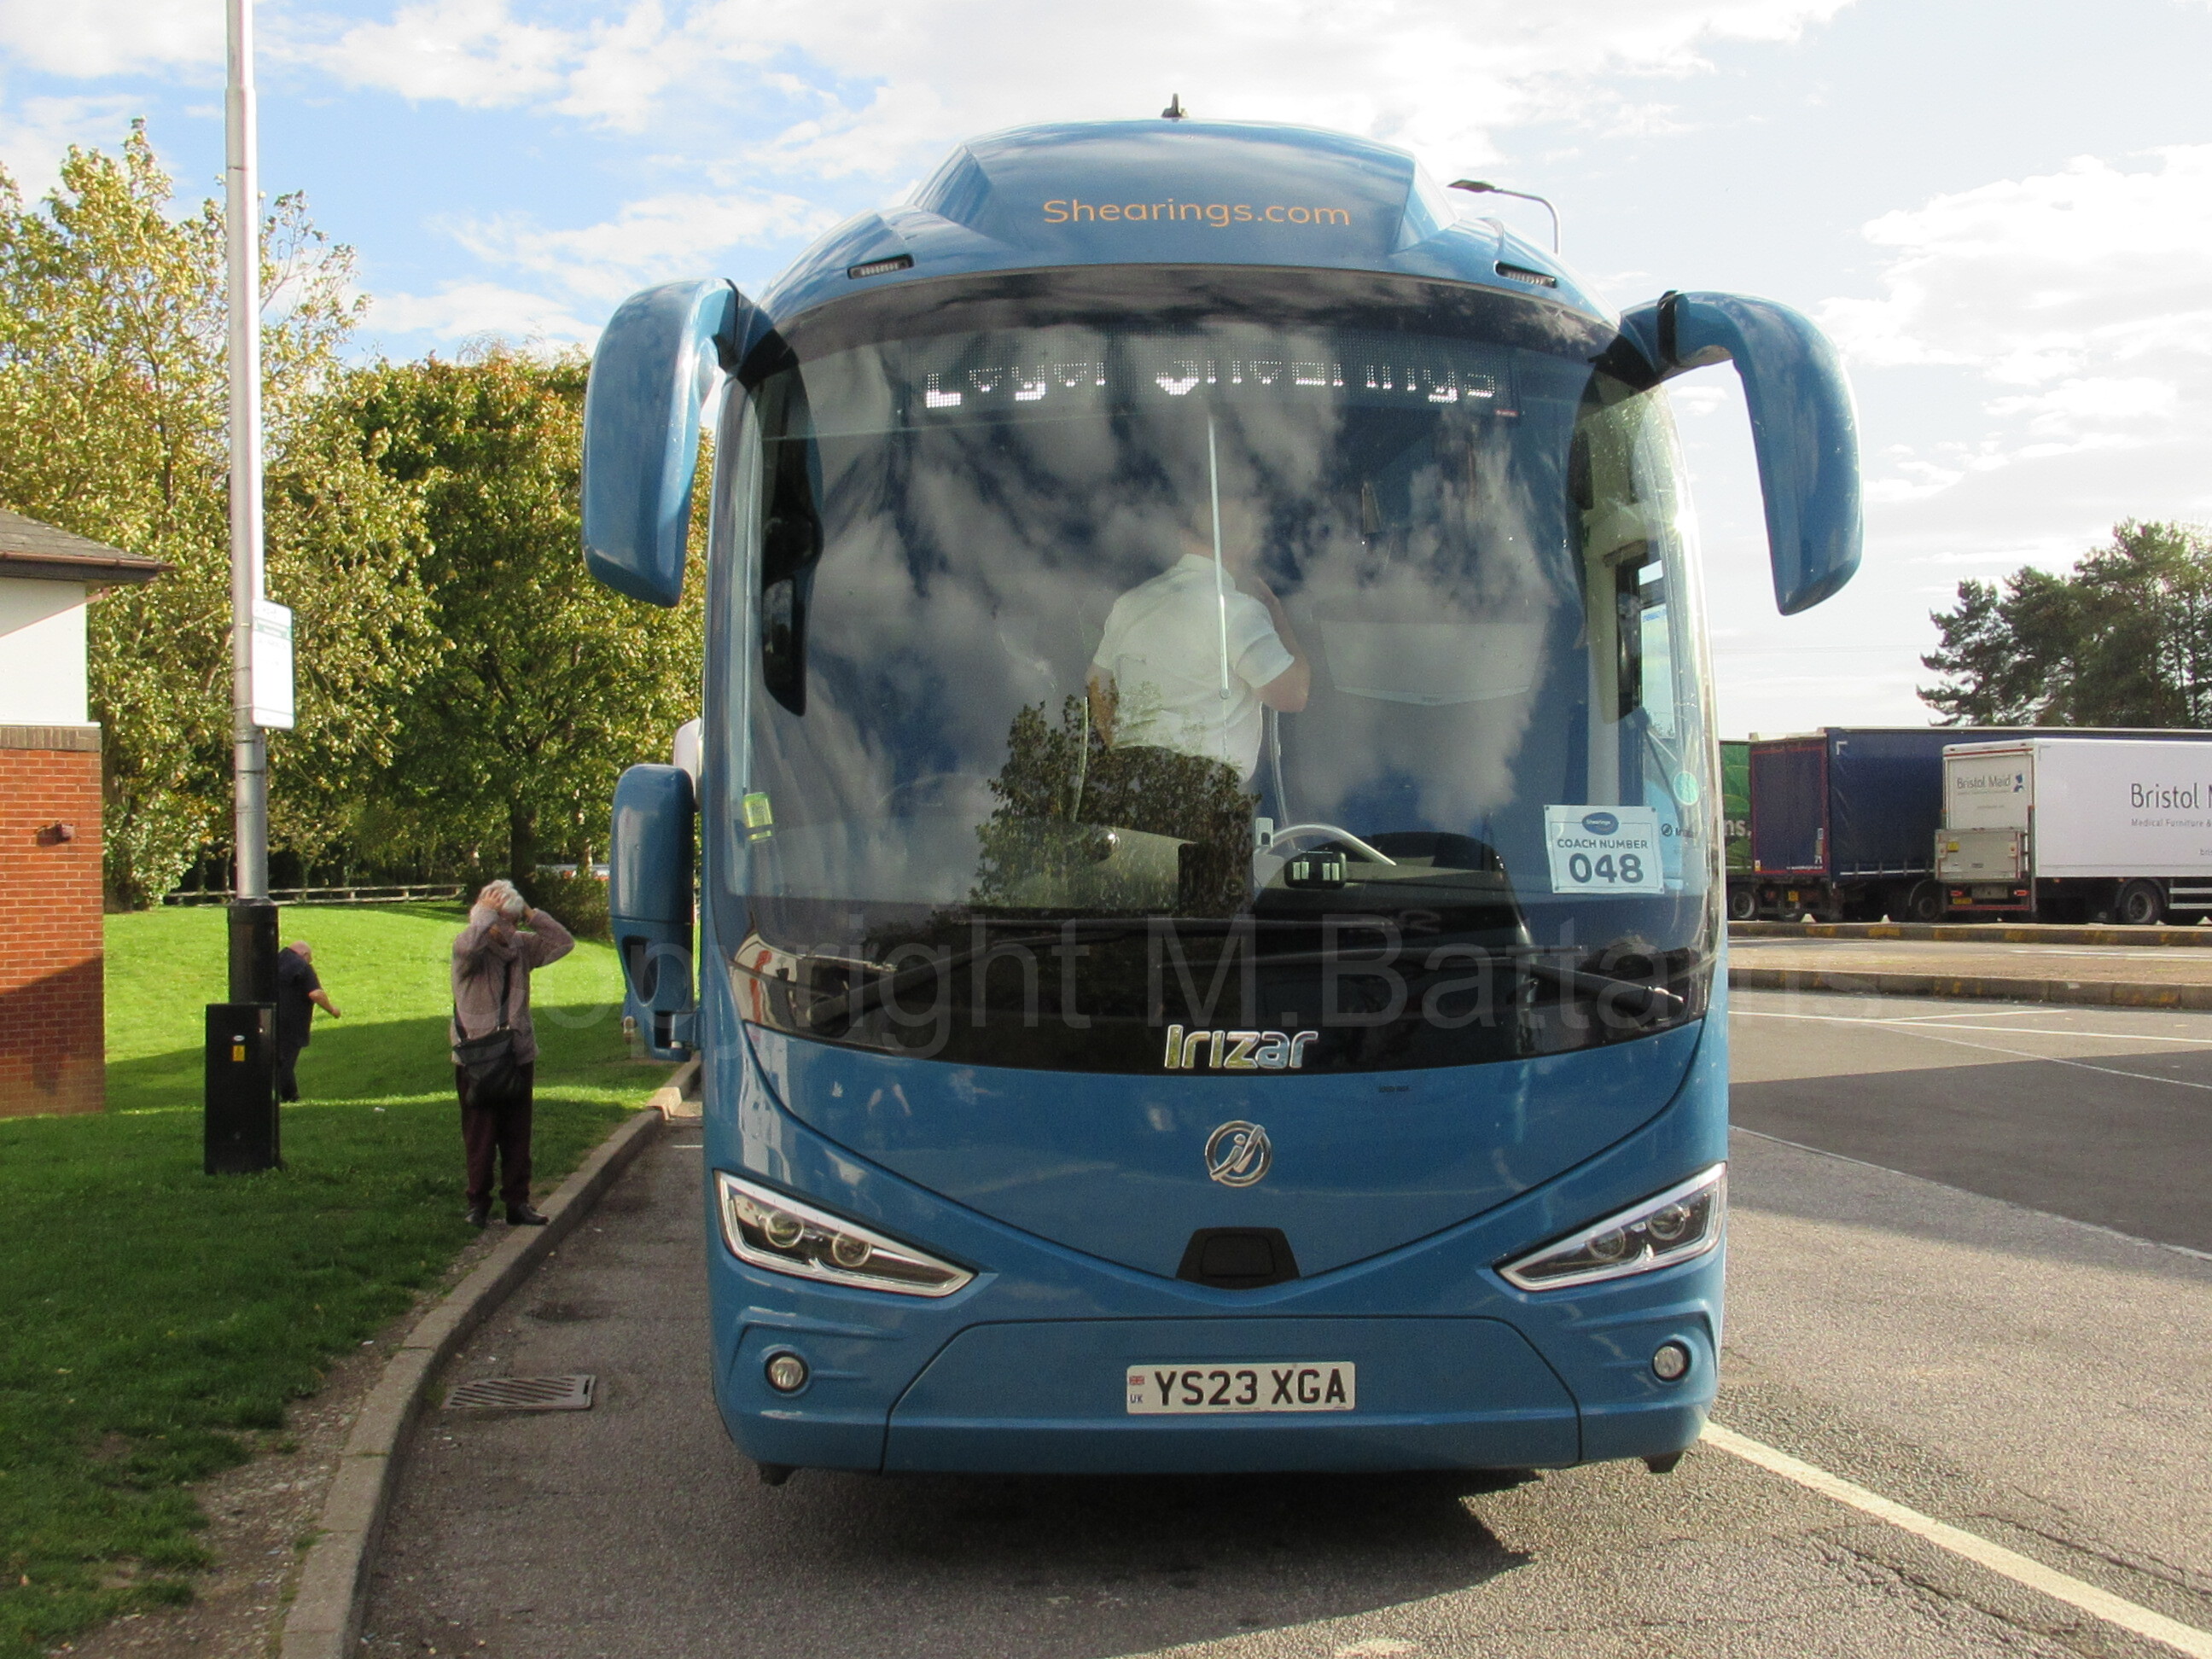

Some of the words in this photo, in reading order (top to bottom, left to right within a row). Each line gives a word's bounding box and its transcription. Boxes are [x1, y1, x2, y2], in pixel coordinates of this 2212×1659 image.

[1043, 198, 1351, 228] Shearings.com
[1957, 775, 1985, 789] Bristol
[1988, 773, 2011, 787] Maid
[2131, 783, 2199, 809] Bristol
[2131, 818, 2163, 827] Medical
[2166, 818, 2203, 827] Furniture
[1557, 839, 1597, 849] COACH
[1600, 839, 1648, 849] NUMBER
[1569, 853, 1644, 883] 048
[1164, 1024, 1319, 1069] Irizar
[1130, 1394, 1143, 1404] UK
[1155, 1371, 1258, 1406] YS23
[1271, 1368, 1347, 1405] XGA
